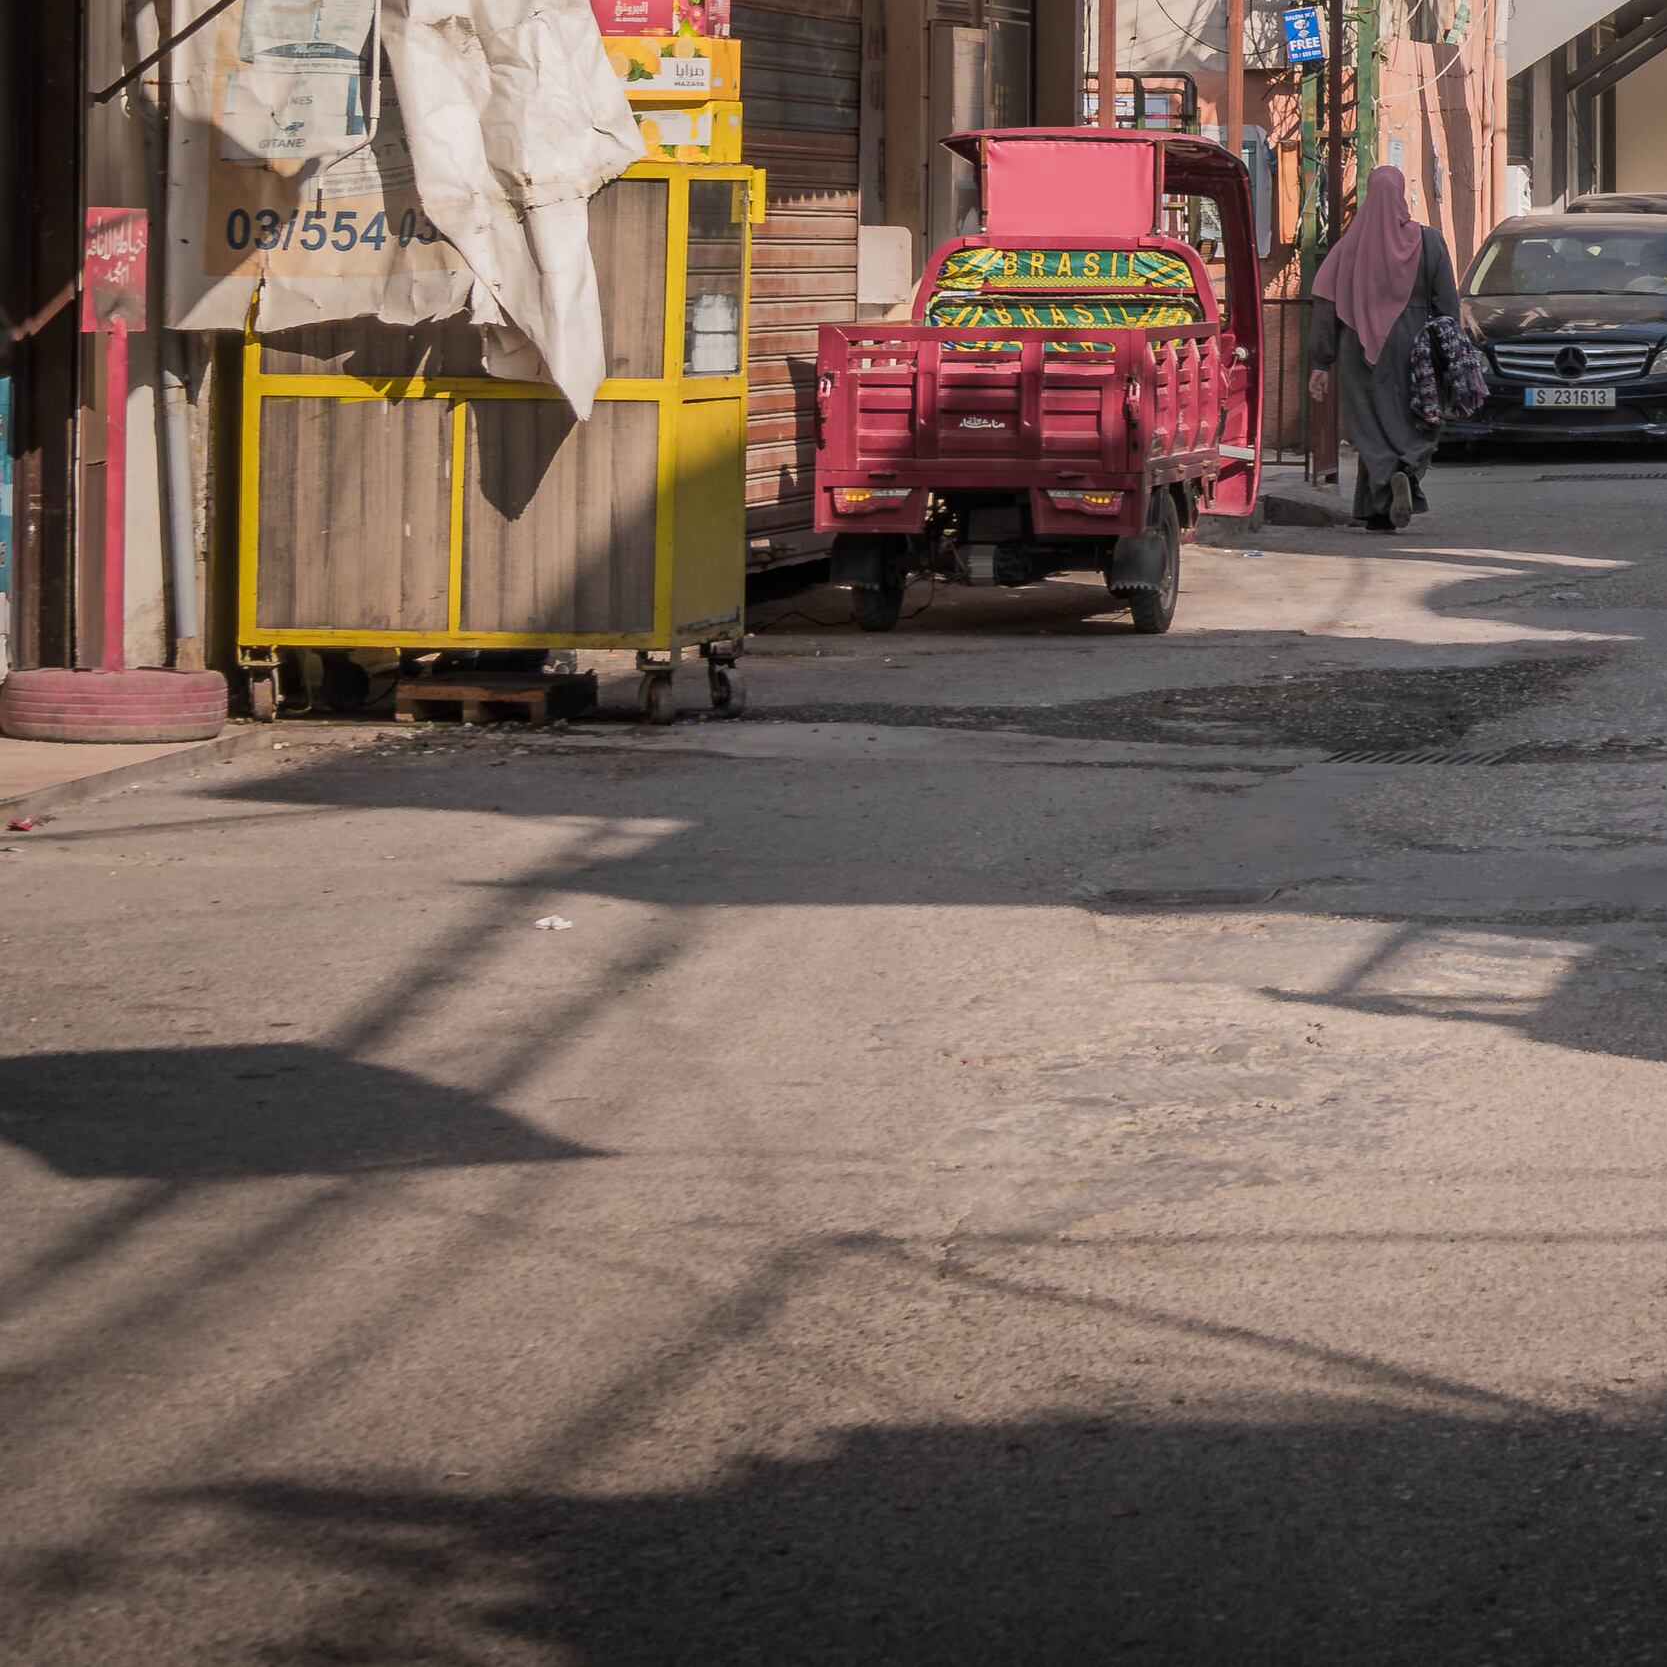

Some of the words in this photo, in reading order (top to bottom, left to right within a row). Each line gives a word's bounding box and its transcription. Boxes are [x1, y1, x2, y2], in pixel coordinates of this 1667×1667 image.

[1290, 37, 1321, 52] FREE
[225, 207, 387, 252] 03/554
[1002, 251, 1141, 278] BRASIL
[992, 302, 1138, 327] BRASIL
[1536, 389, 1546, 405] S
[1554, 389, 1607, 405] 231613
